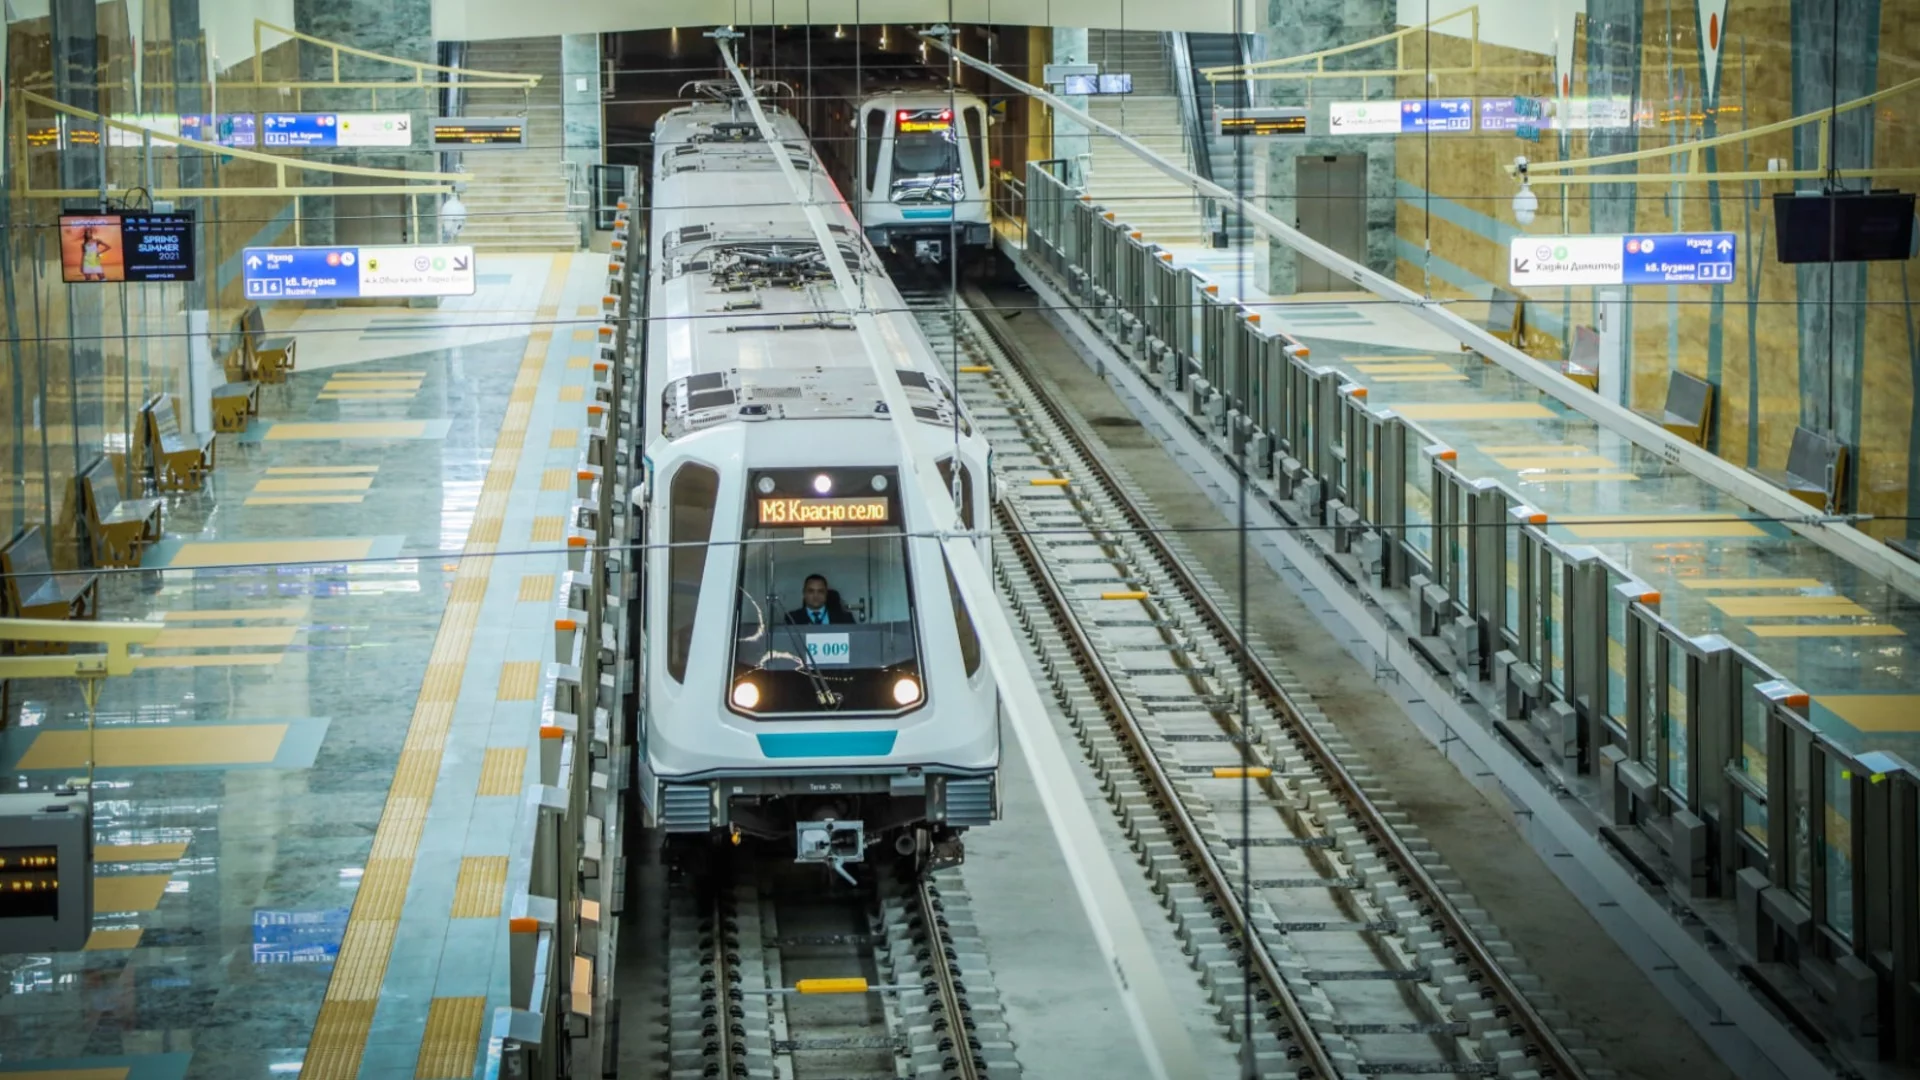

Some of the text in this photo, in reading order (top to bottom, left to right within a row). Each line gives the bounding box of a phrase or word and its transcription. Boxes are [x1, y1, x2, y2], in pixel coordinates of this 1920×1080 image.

[143, 235, 179, 244] SPRING
[1686, 237, 1713, 248] Изход
[138, 244, 180, 252] SUMMER
[158, 252, 180, 261] 2021
[266, 253, 294, 264] Изход
[1535, 261, 1621, 273] Хаджи Димитър
[788, 499, 845, 522] Красно
[847, 503, 885, 520] село
[822, 642, 849, 657] 009
